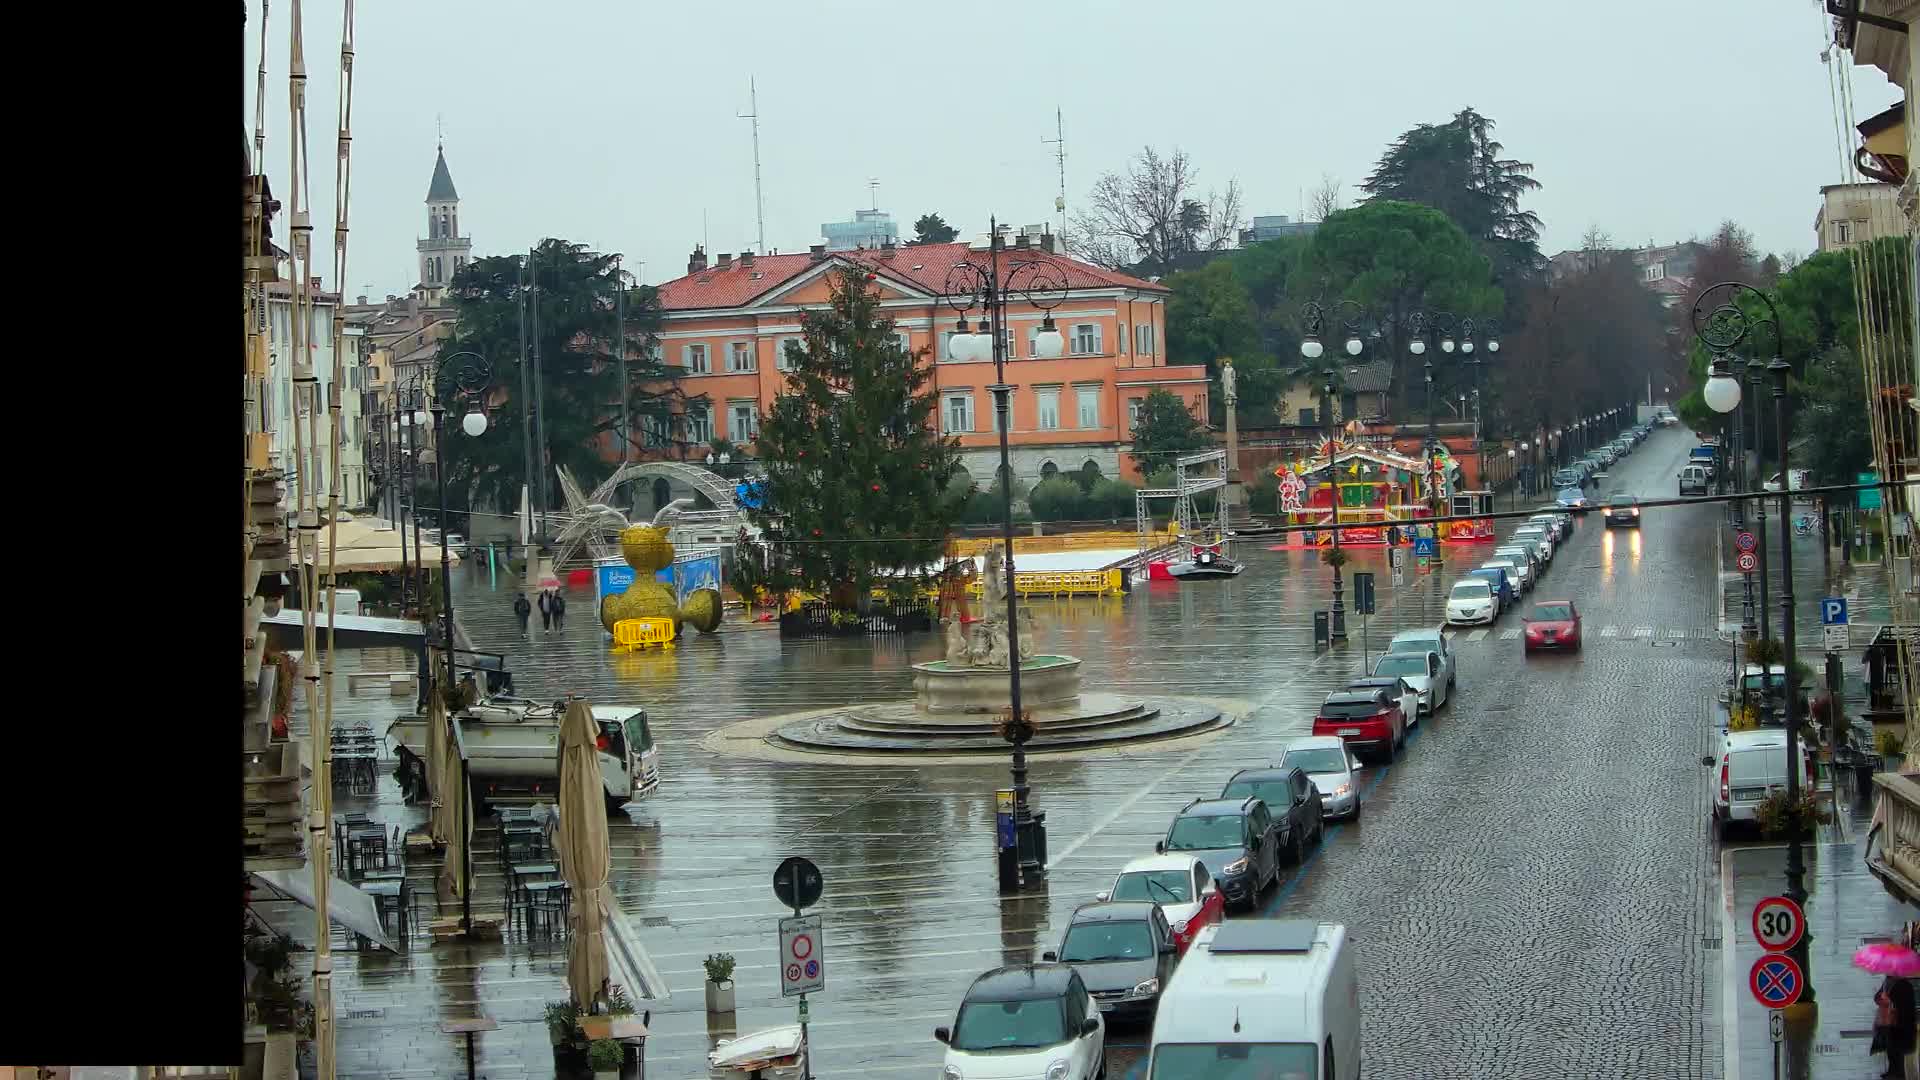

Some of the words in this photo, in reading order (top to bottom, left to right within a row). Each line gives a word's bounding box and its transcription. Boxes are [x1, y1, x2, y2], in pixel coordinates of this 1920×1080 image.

[1742, 557, 1752, 567] 20
[1826, 602, 1842, 622] P
[1762, 911, 1792, 937] 30
